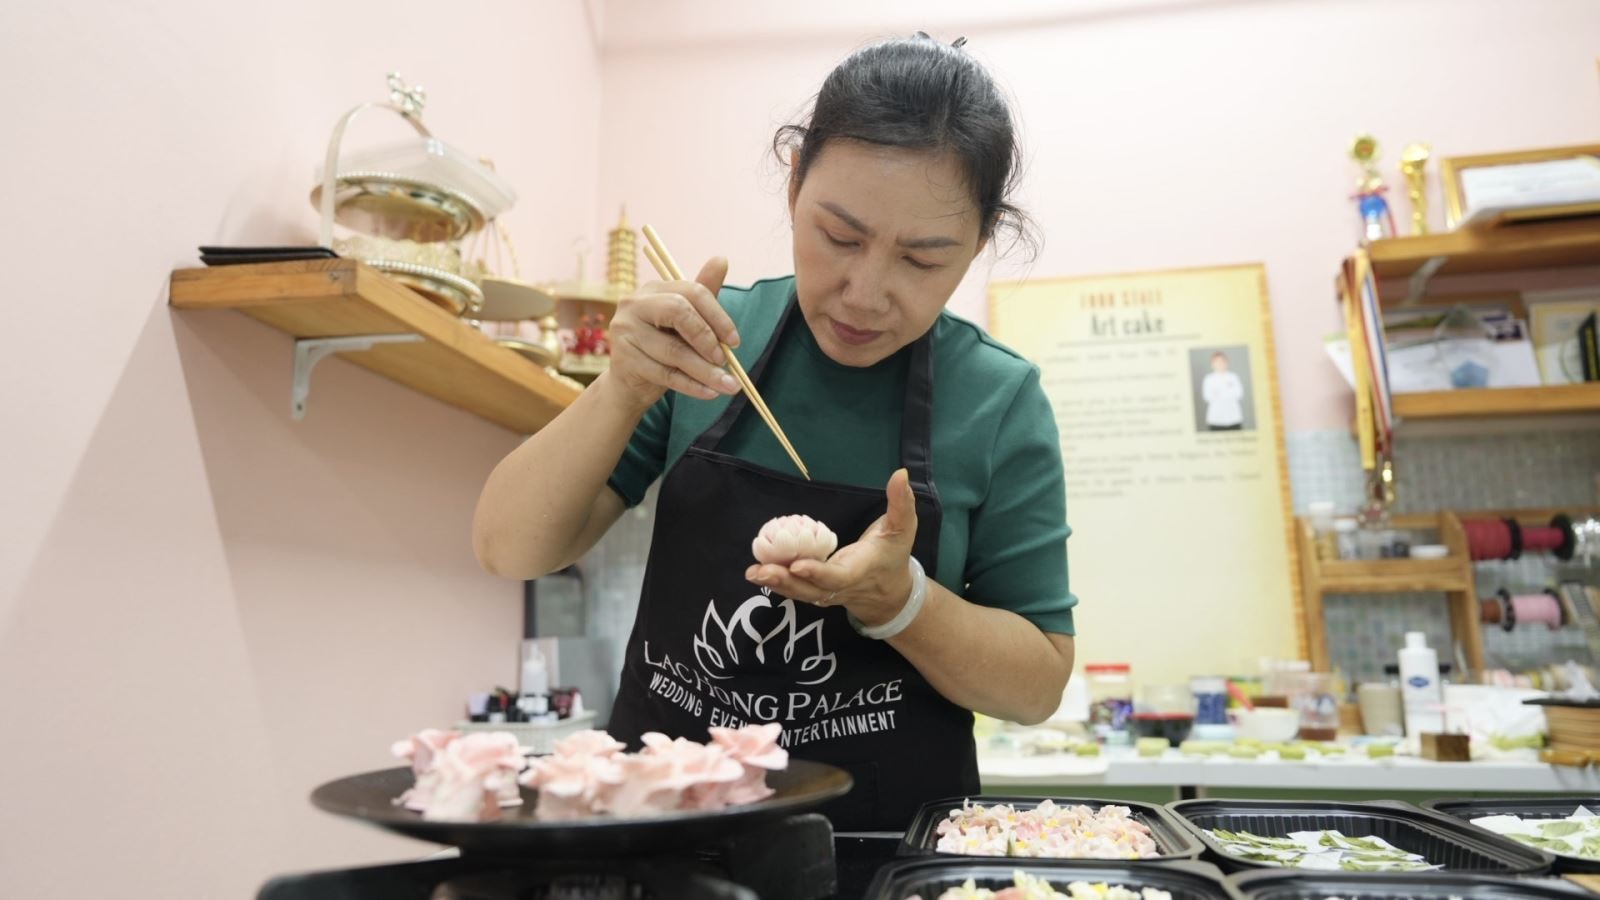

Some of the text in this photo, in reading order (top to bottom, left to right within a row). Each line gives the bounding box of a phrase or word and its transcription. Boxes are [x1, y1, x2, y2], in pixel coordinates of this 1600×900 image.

[1091, 309, 1165, 337] Art cake
[644, 640, 903, 721] LAC HONG PALACE
[649, 671, 896, 748] WEDDING EVEN NTERTAINMENT
